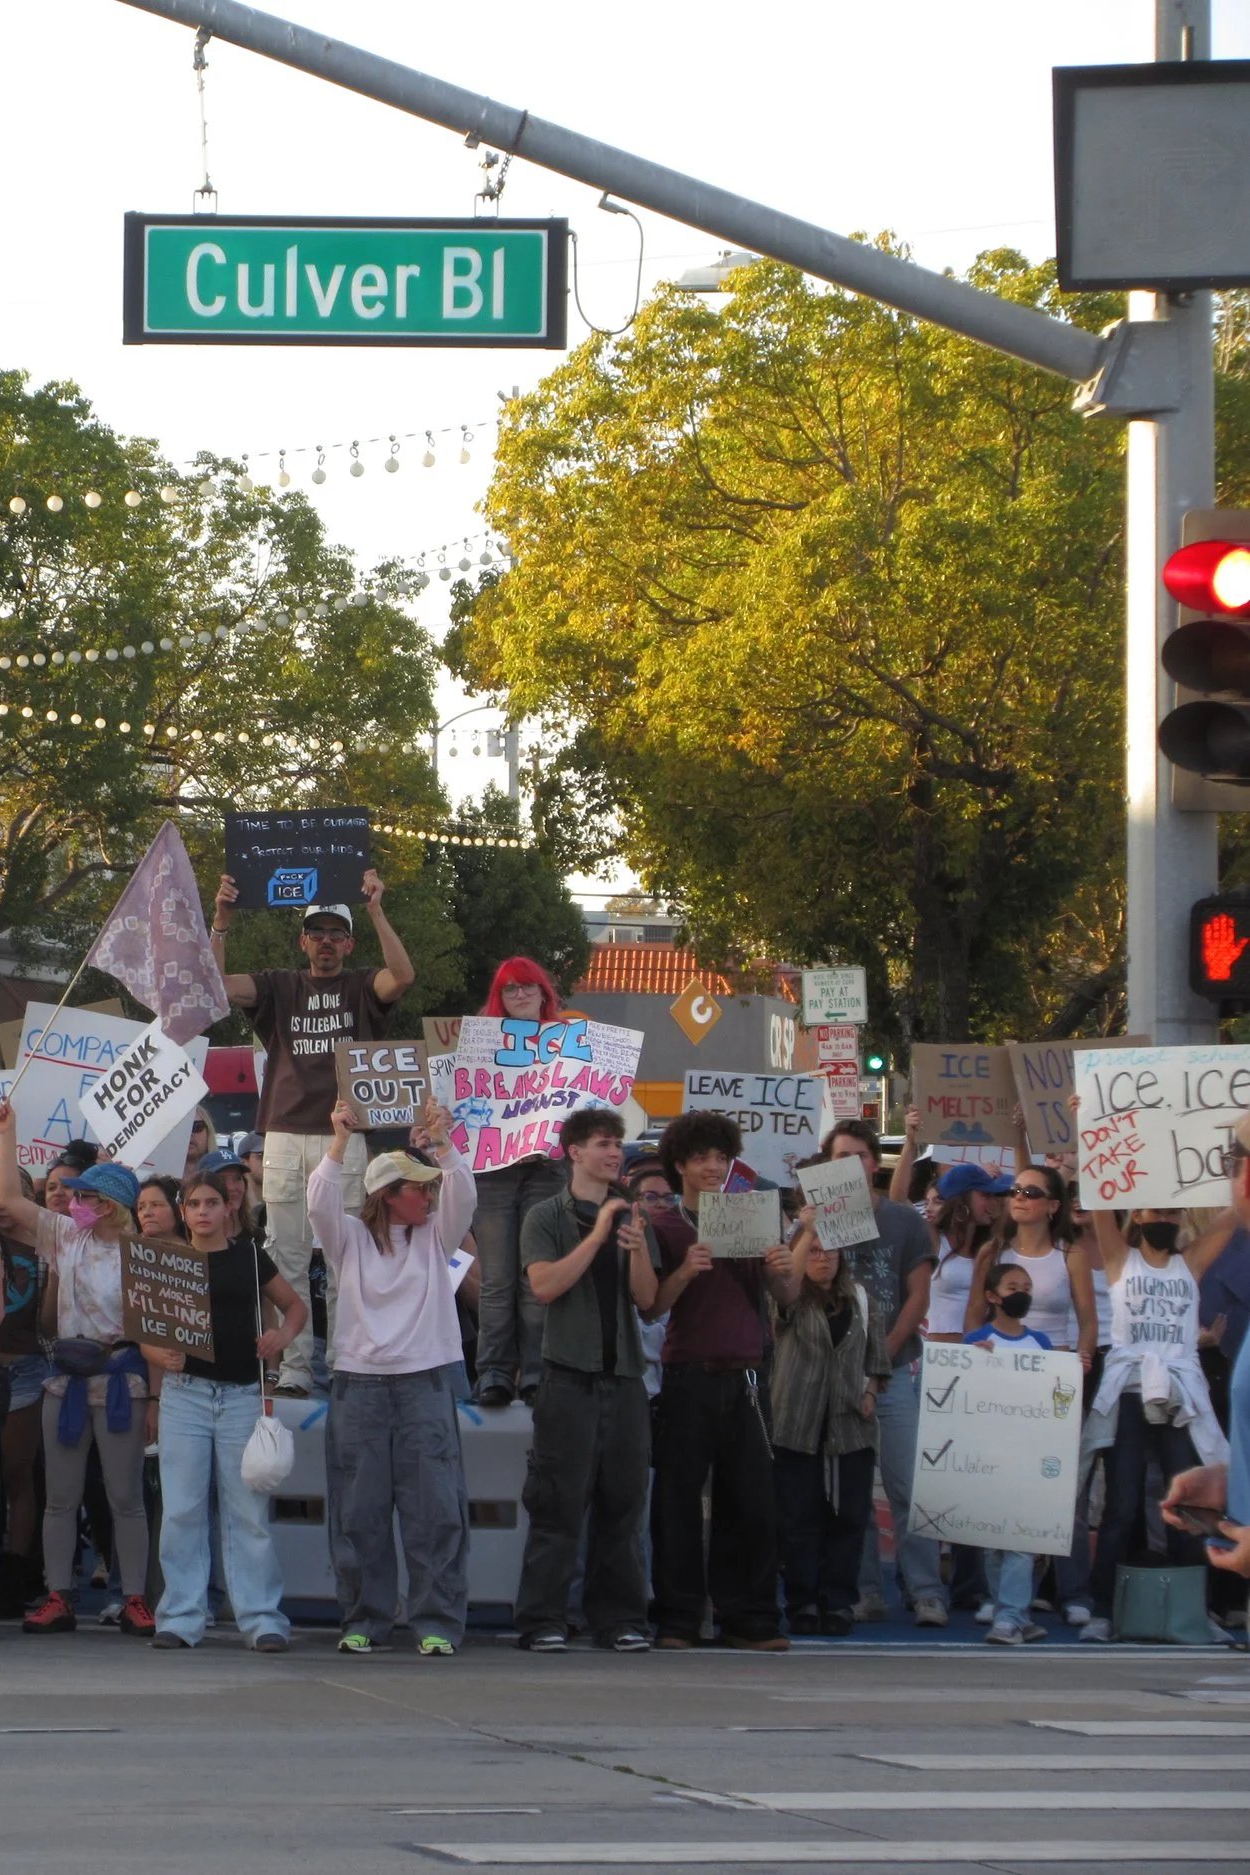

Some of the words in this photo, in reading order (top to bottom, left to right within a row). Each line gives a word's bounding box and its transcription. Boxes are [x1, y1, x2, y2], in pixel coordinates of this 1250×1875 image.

[186, 242, 420, 318] Culver
[442, 246, 505, 320] Bl
[236, 818, 271, 831] TIME
[276, 820, 293, 830] TO
[301, 818, 317, 829] BE
[251, 845, 295, 857] PROTECT
[301, 846, 324, 855] OUR
[278, 887, 303, 898] ICE
[307, 994, 320, 1011] NO
[322, 993, 341, 1009] ONE
[809, 999, 823, 1009] PAY
[828, 997, 861, 1009] STATION
[821, 987, 835, 997] PAY
[839, 986, 849, 996] AT
[291, 1015, 301, 1032] IS
[302, 1014, 343, 1033] ILLEGAL
[819, 1028, 829, 1040] NO
[829, 1027, 854, 1039] PARKING
[292, 1038, 329, 1055] STOLEN
[494, 1018, 593, 1067] ICE
[93, 1034, 159, 1111] HONK
[348, 1047, 421, 1074] ICE
[938, 1053, 990, 1079] ICE
[113, 1068, 161, 1122] FOR
[352, 1078, 426, 1106] OUT
[454, 1066, 550, 1101] BREAKS
[550, 1062, 636, 1105] LAWS
[689, 1075, 745, 1098] LEAVE
[750, 1076, 814, 1111] ICE
[831, 1076, 857, 1088] PARKING
[106, 1062, 193, 1159] DEMOCRACY
[368, 1106, 414, 1126] NOW!
[1036, 1101, 1070, 1144] IS
[769, 1112, 814, 1136] TEA
[1080, 1110, 1139, 1152] DON'T
[1081, 1133, 1146, 1180] TAKE
[1100, 1159, 1148, 1201] OUR
[823, 1195, 852, 1217] NOT
[129, 1242, 157, 1264] NO
[160, 1253, 205, 1278] MORE
[128, 1263, 210, 1294] KIDNAPPING!
[1126, 1275, 1193, 1300] MIGRATION
[134, 1281, 151, 1293] NO
[158, 1287, 197, 1308] MORE
[1152, 1298, 1167, 1317] IS
[127, 1288, 211, 1328] KILLING!
[141, 1316, 167, 1337] ICE
[927, 1347, 973, 1370] USES
[1013, 1353, 1046, 1373] ICE:
[964, 1390, 1050, 1420] Lemonade
[951, 1455, 999, 1476] Water
[939, 1511, 1007, 1537] National
[1011, 1519, 1072, 1549] Security
